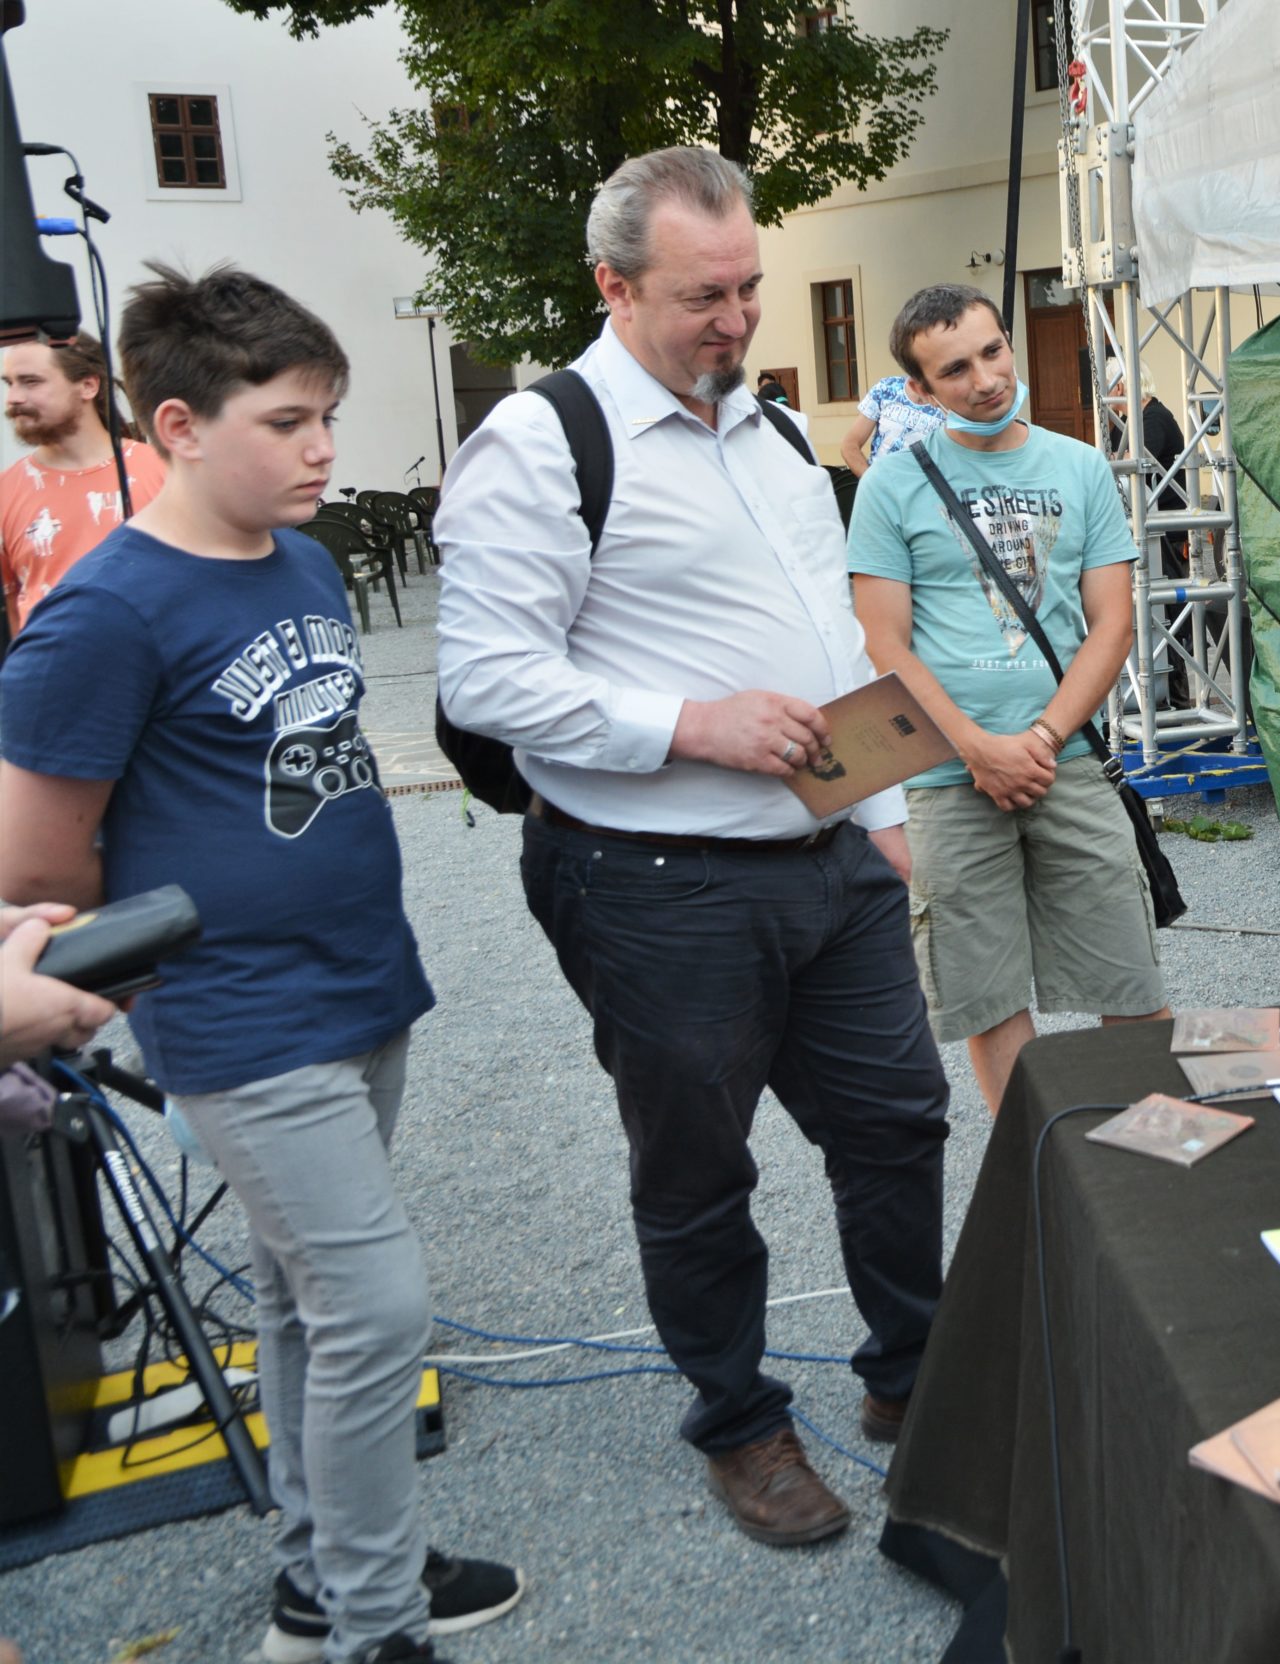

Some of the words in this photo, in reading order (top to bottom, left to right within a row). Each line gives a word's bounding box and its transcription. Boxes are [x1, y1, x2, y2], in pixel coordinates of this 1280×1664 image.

[981, 485, 1063, 517] STREETS
[989, 520, 1028, 535] DRIVING
[991, 537, 1031, 553] AROUND
[210, 630, 292, 722] JUST
[275, 618, 308, 670] 5
[972, 659, 1000, 669] JUST
[1006, 660, 1027, 669] FOR
[104, 1150, 145, 1223] Millenium
